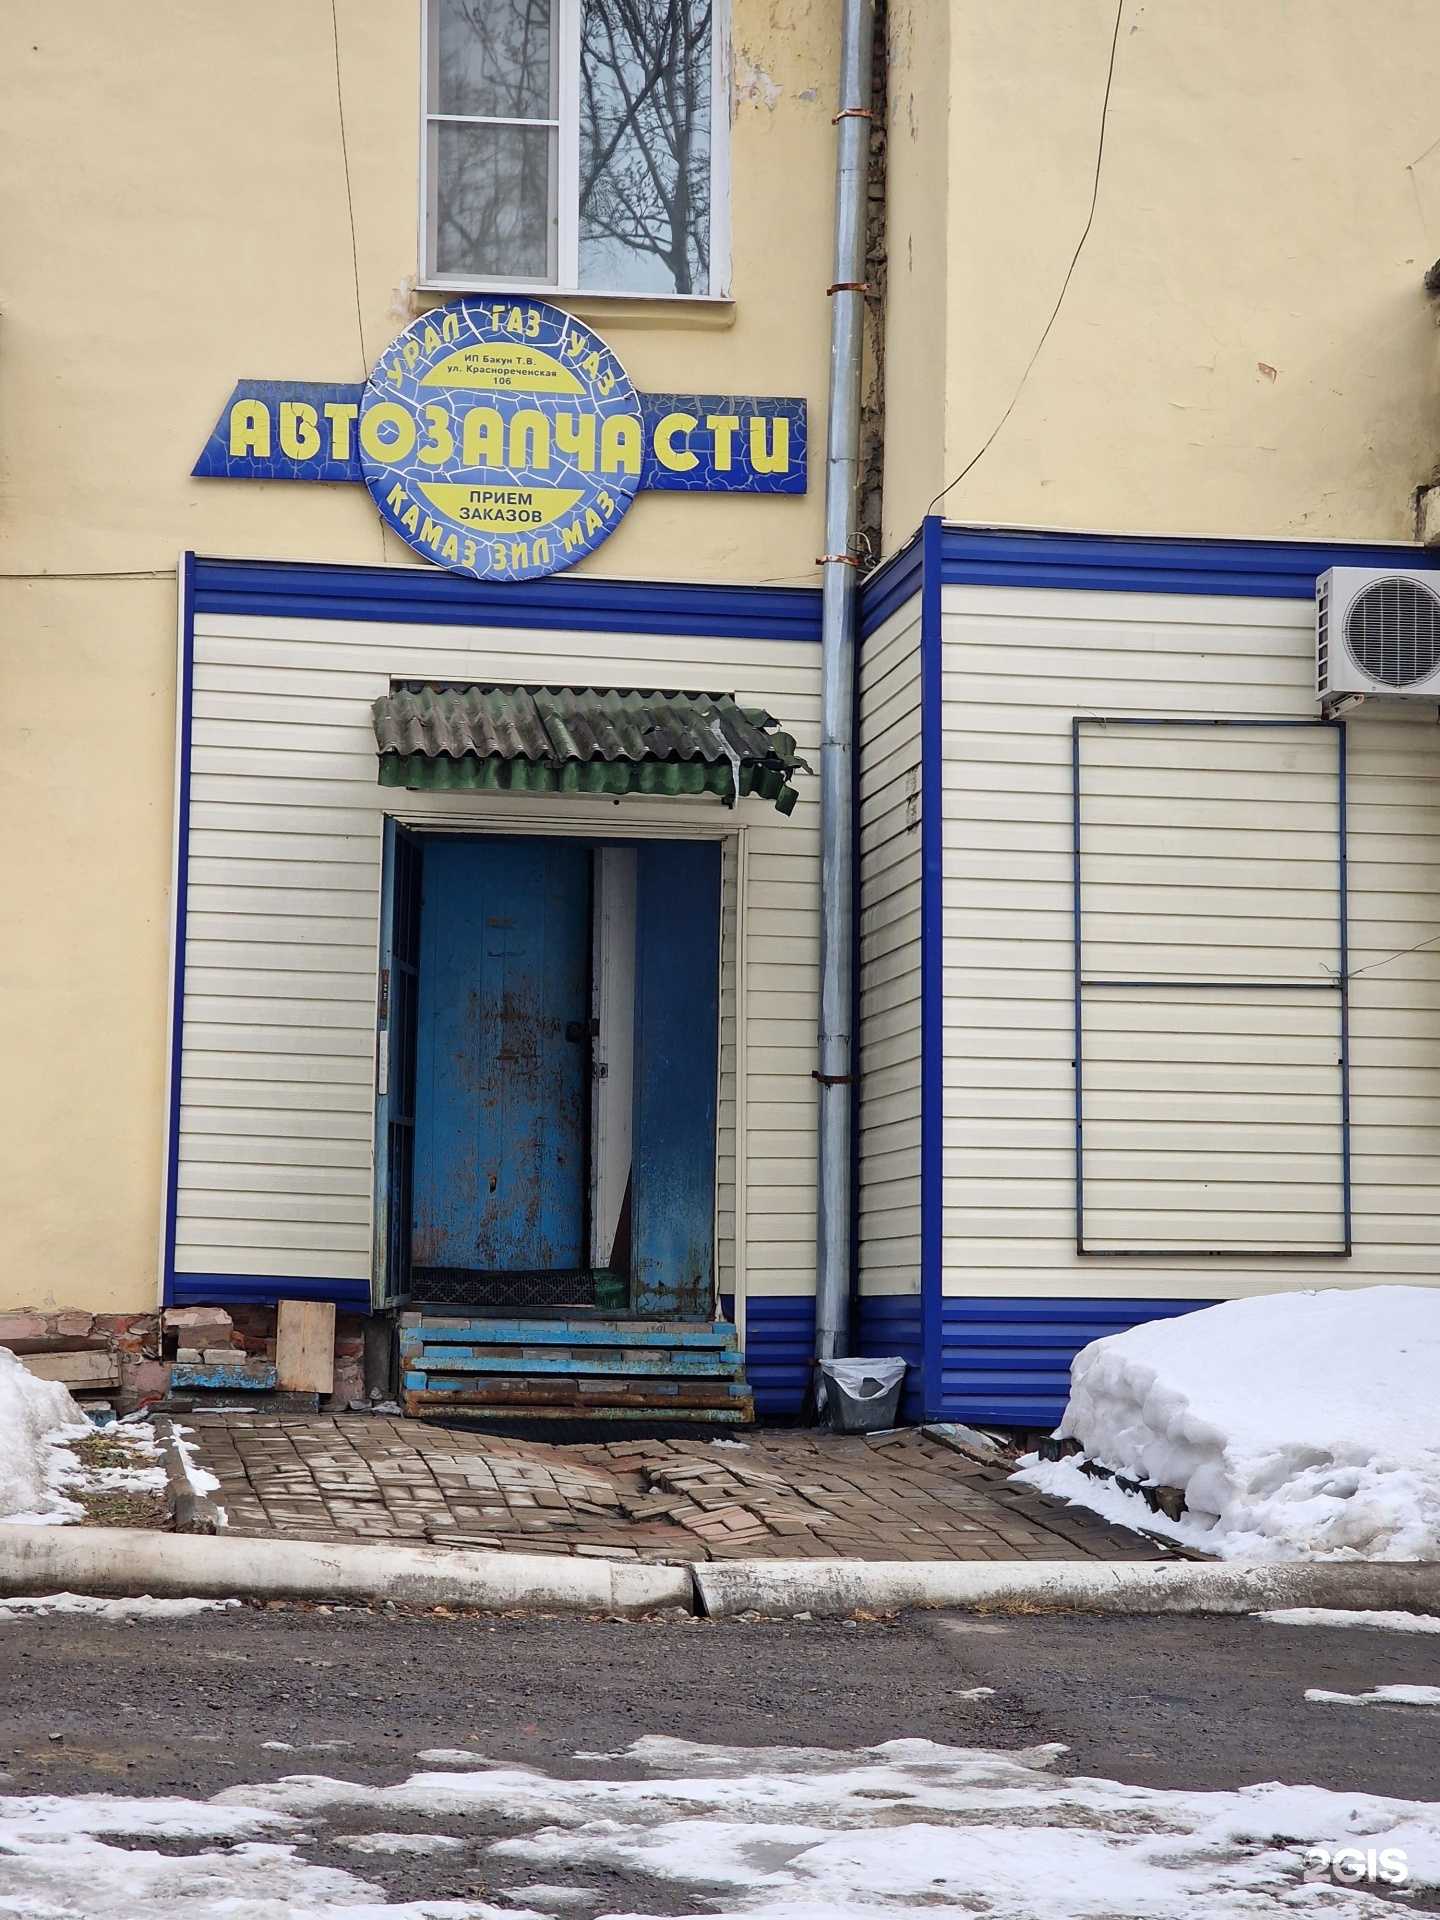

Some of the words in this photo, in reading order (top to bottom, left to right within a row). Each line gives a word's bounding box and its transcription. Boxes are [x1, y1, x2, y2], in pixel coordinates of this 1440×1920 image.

[492, 305, 541, 338] ГАЗ
[387, 313, 460, 388] УРАЛ
[464, 354, 479, 363] ИП
[483, 355, 513, 366] Бакун
[517, 356, 537, 366] Т.В.
[568, 332, 615, 397] УАЗ
[447, 365, 463, 373] ул.
[466, 365, 557, 378] Краснореченская
[459, 506, 542, 523] ЗАКАЗОВ
[469, 490, 533, 506] ПРИЕМ
[386, 481, 477, 568] КАМАЗ
[561, 491, 616, 553] МАЗ
[492, 537, 550, 570] ЗИЛ
